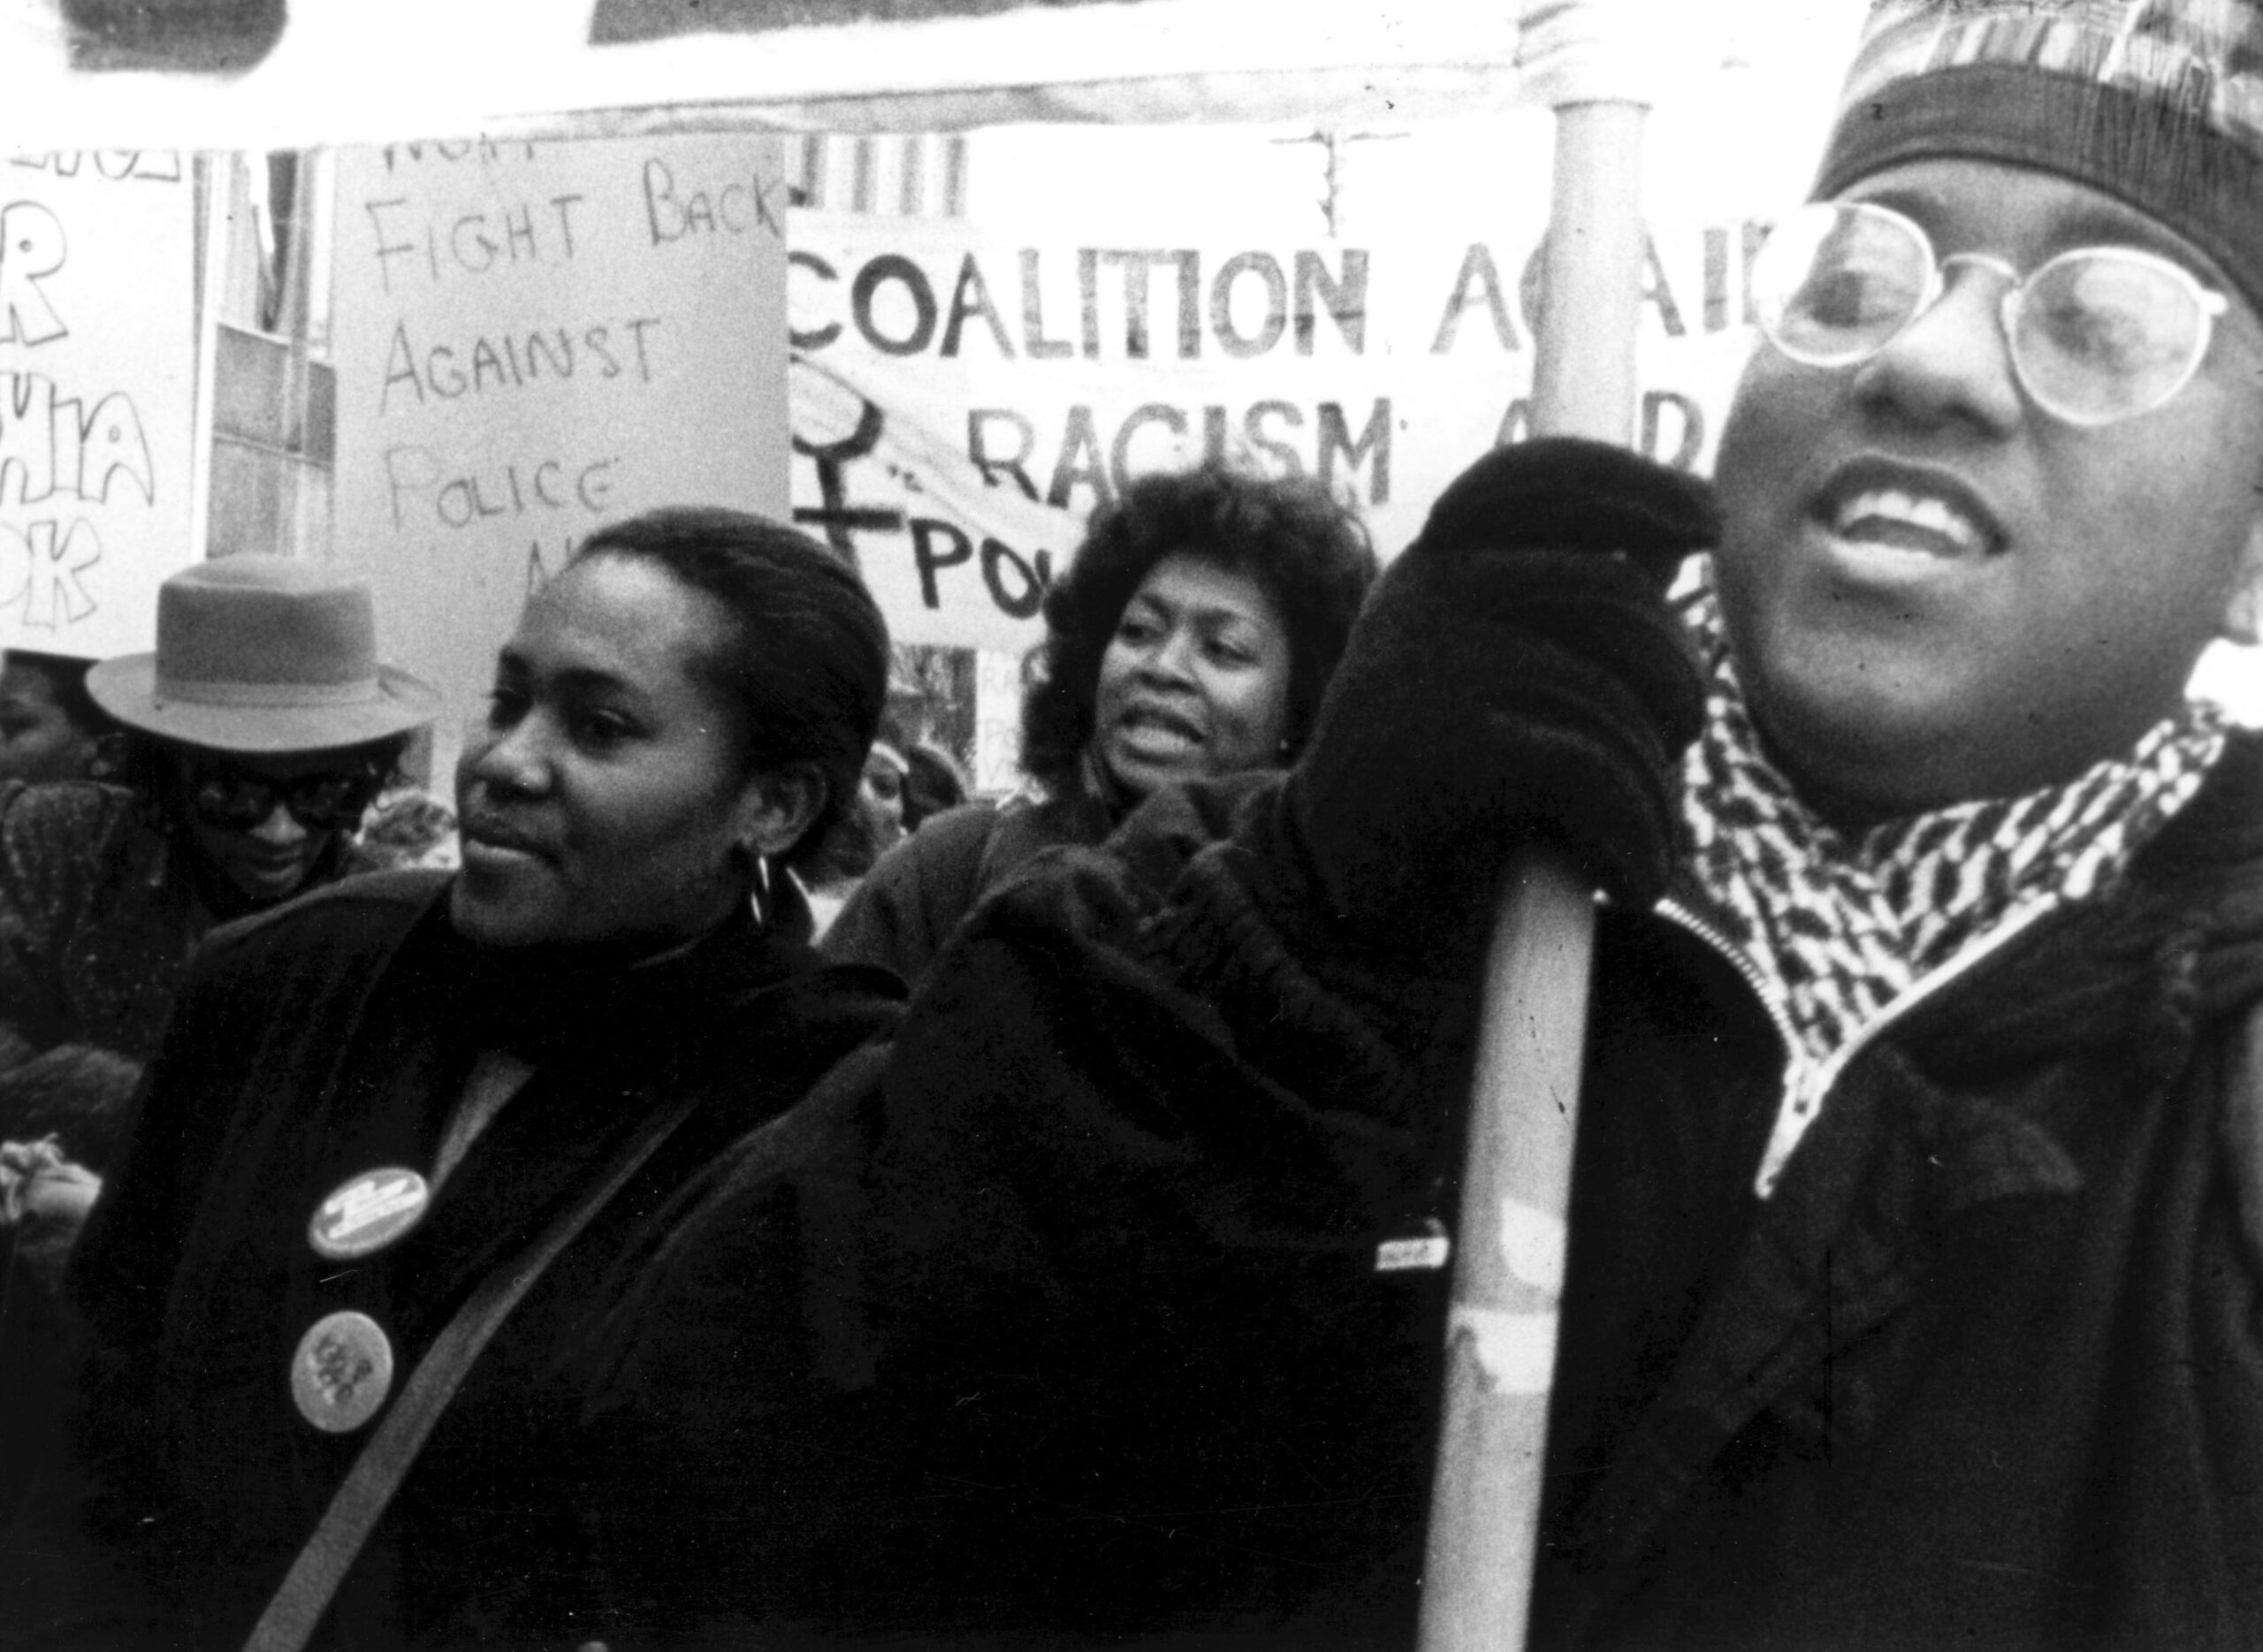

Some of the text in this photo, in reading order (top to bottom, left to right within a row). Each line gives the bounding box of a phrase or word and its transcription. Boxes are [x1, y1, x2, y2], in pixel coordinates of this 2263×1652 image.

[364, 156, 781, 297] FIGHT BACK
[788, 247, 1370, 359] COALITION
[379, 317, 661, 418] AGAINST
[968, 396, 1391, 512] RACISM
[908, 518, 1052, 620] PO
